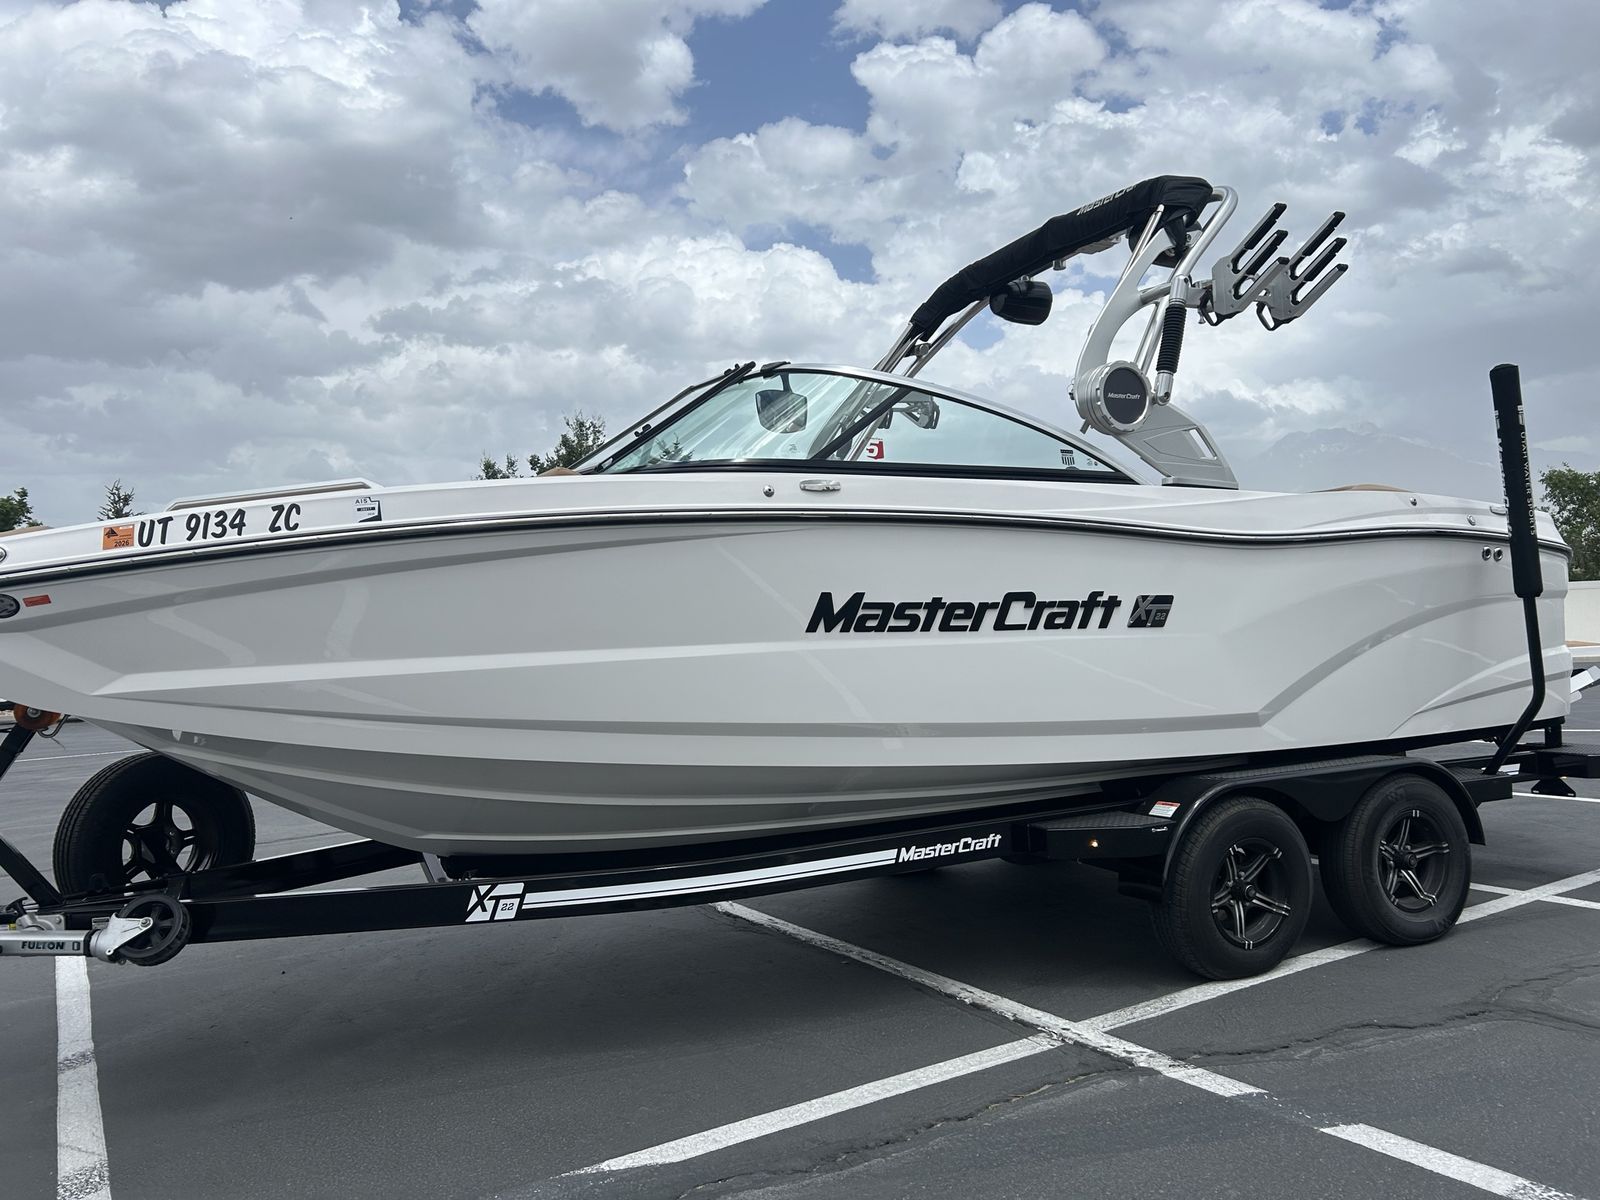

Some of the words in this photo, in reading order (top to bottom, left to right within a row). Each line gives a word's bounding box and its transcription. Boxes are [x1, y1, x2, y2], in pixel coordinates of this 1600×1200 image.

[1107, 392, 1141, 400] MasterCraft
[1523, 461, 1531, 494] WATER
[137, 516, 174, 547] UT
[186, 508, 246, 541] 9134
[268, 503, 301, 533] ZC
[1526, 497, 1536, 536] SPORTS
[805, 591, 1122, 633] MasterCraft
[898, 833, 1002, 863] MasterCraft
[21, 941, 65, 950] FULTON
